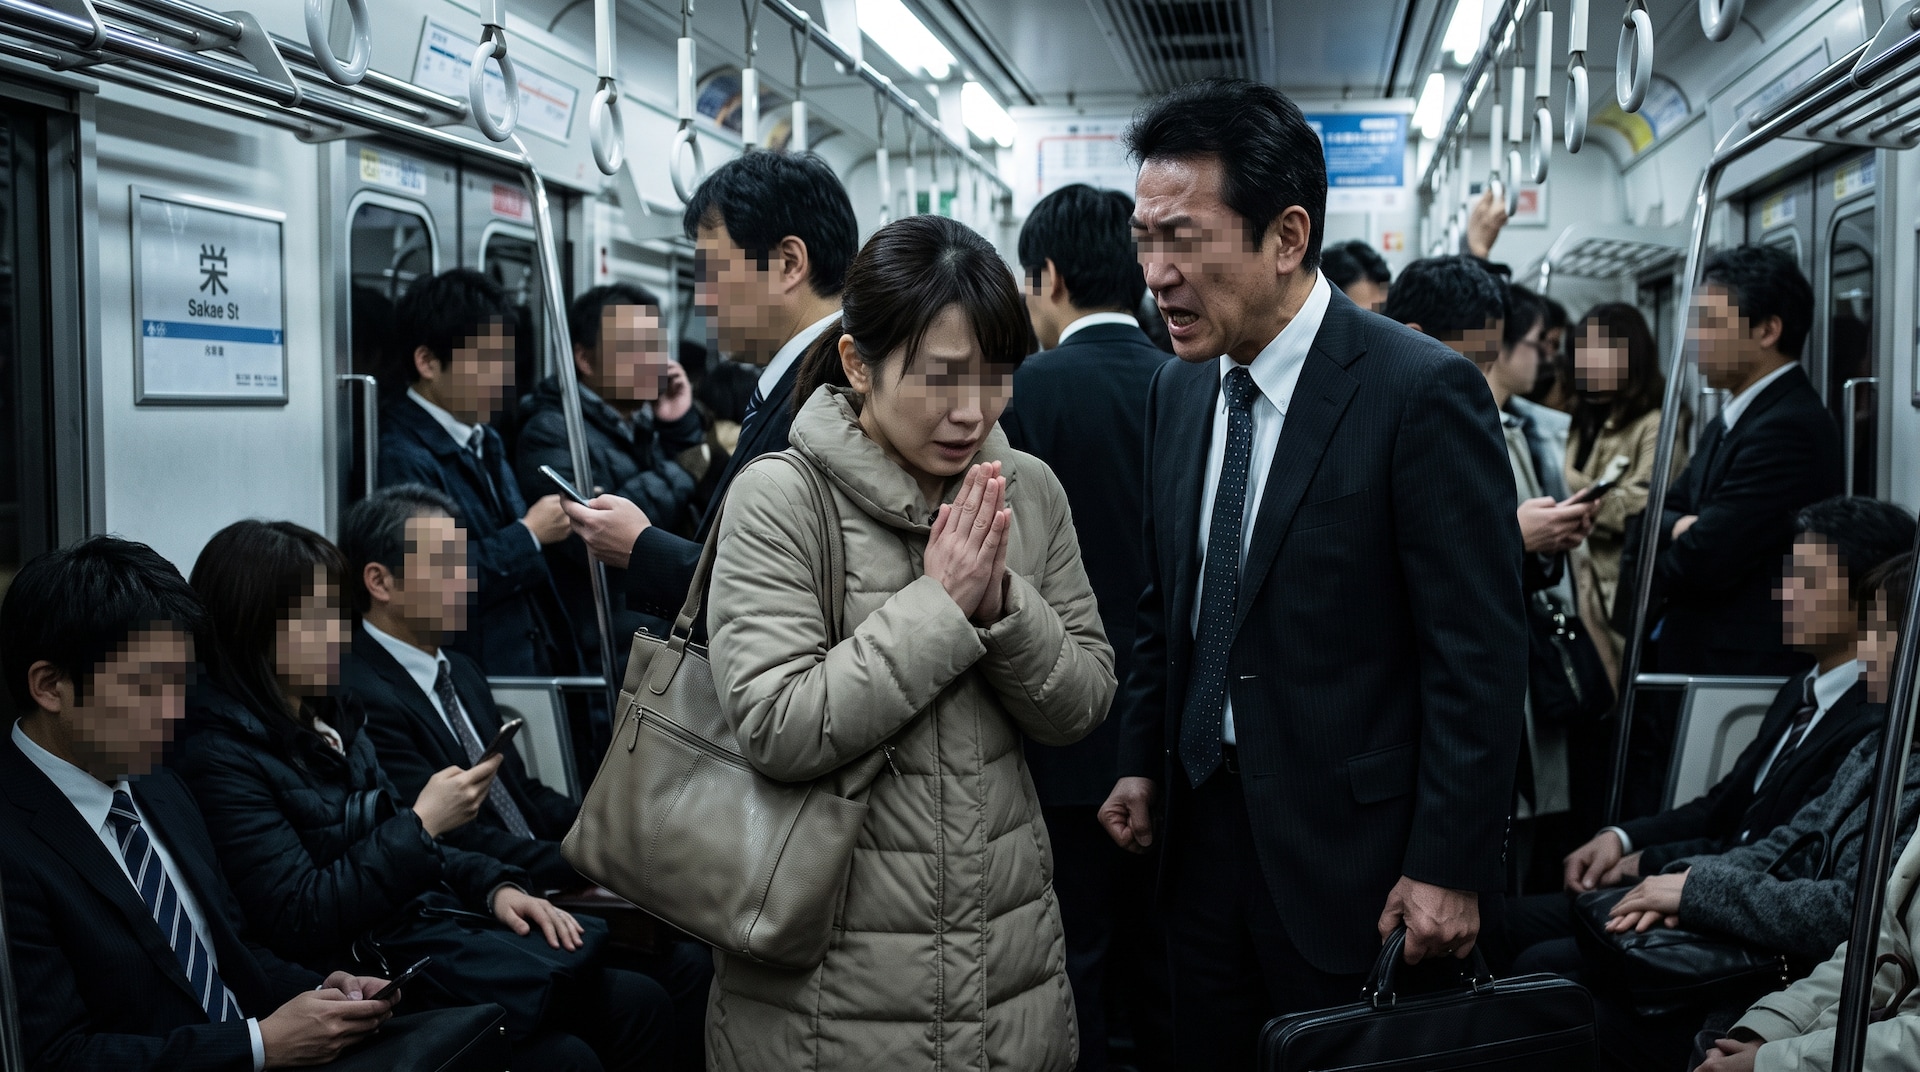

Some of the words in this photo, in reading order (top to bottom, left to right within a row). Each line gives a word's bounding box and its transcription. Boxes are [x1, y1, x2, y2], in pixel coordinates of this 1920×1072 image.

[200, 243, 229, 296] 栄
[188, 299, 224, 319] Sakae
[227, 302, 240, 320] St
